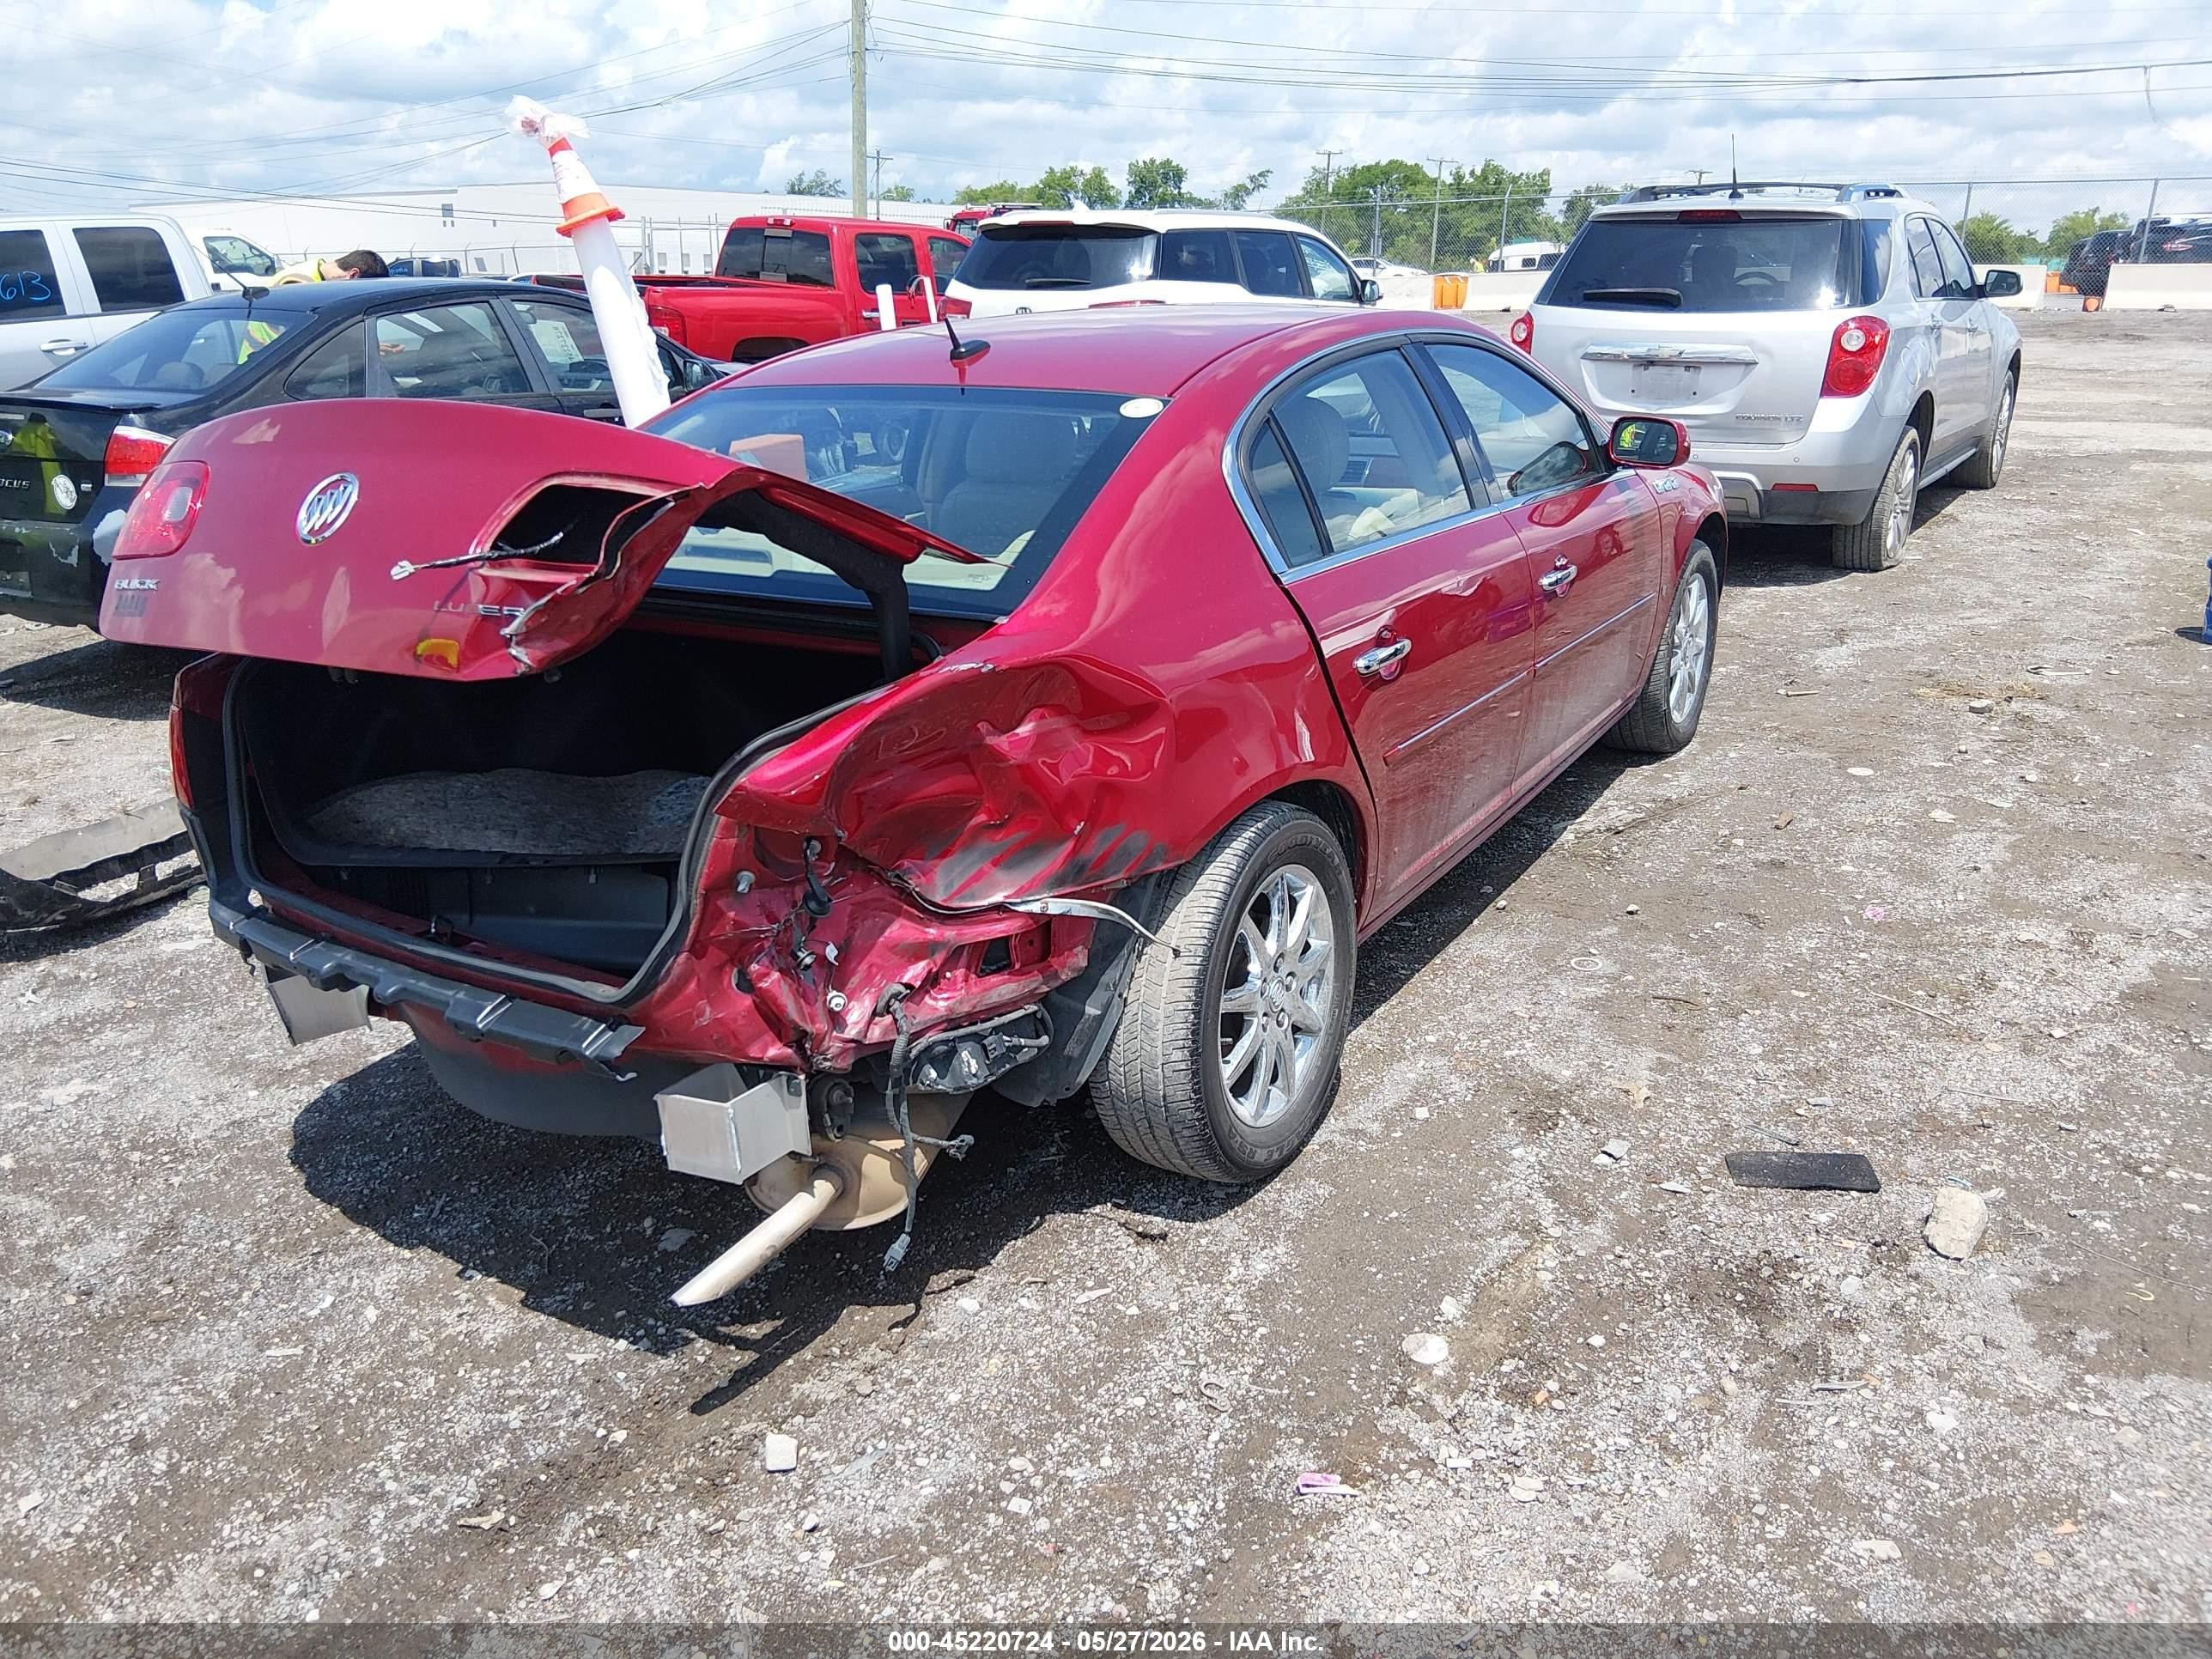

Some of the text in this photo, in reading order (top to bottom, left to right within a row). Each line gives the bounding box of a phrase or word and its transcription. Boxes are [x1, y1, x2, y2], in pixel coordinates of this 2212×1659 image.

[1735, 413, 1803, 422] EQUINOX LTZ
[114, 579, 161, 591] BUICK
[1267, 834, 1344, 877] GOODYEAR
